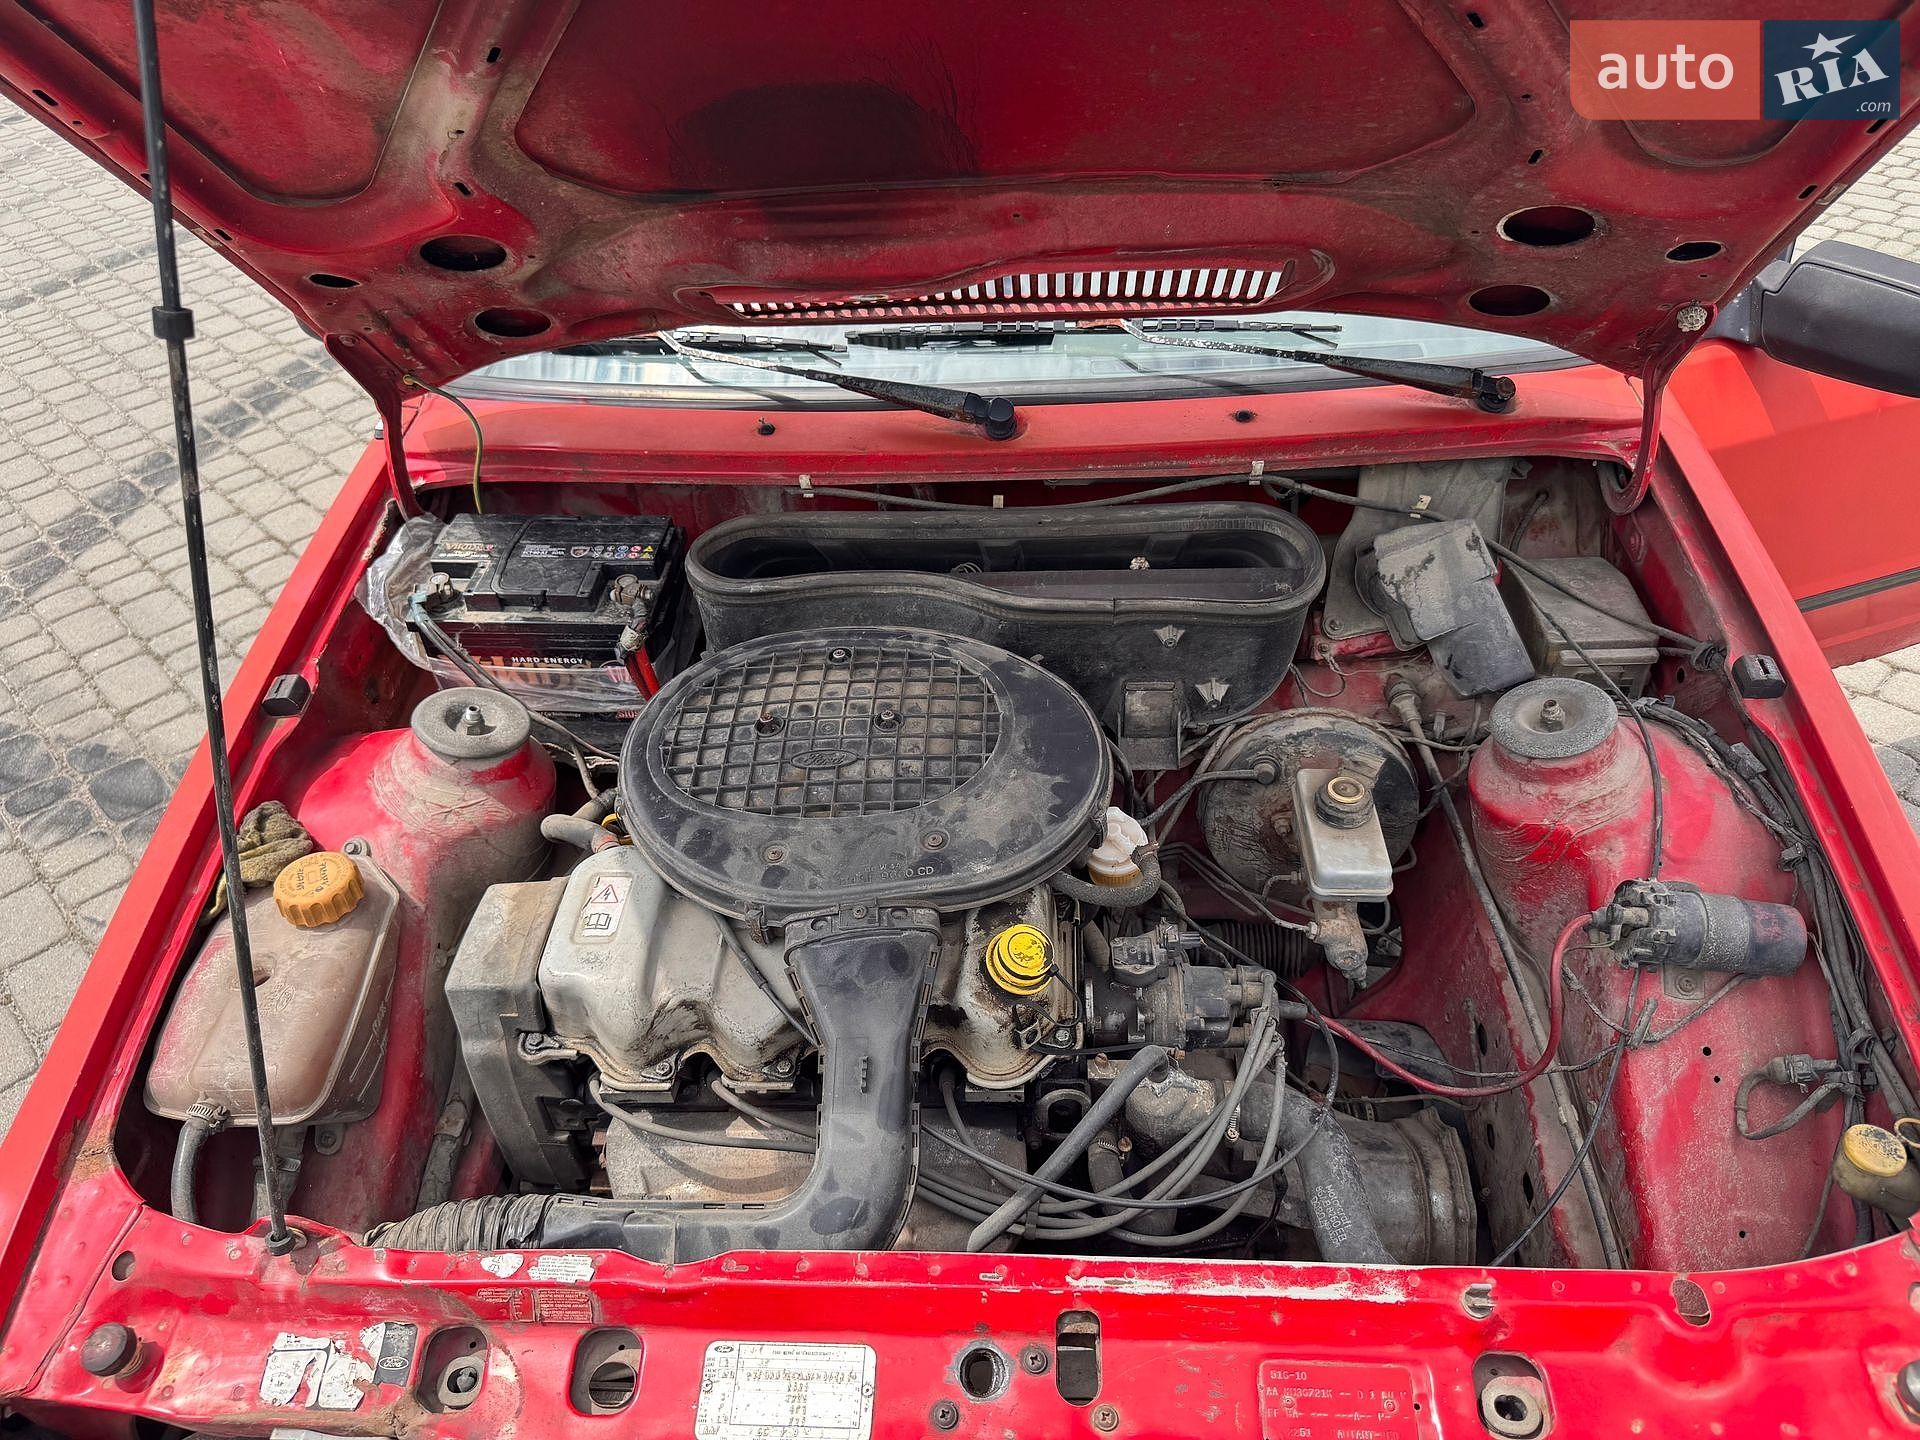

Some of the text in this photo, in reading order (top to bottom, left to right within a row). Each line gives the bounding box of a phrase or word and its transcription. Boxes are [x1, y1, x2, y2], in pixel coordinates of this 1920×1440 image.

[511, 656, 584, 665] HARD ENERGY
[803, 753, 846, 766] Ford
[1325, 1184, 1353, 1229] Motorcraft
